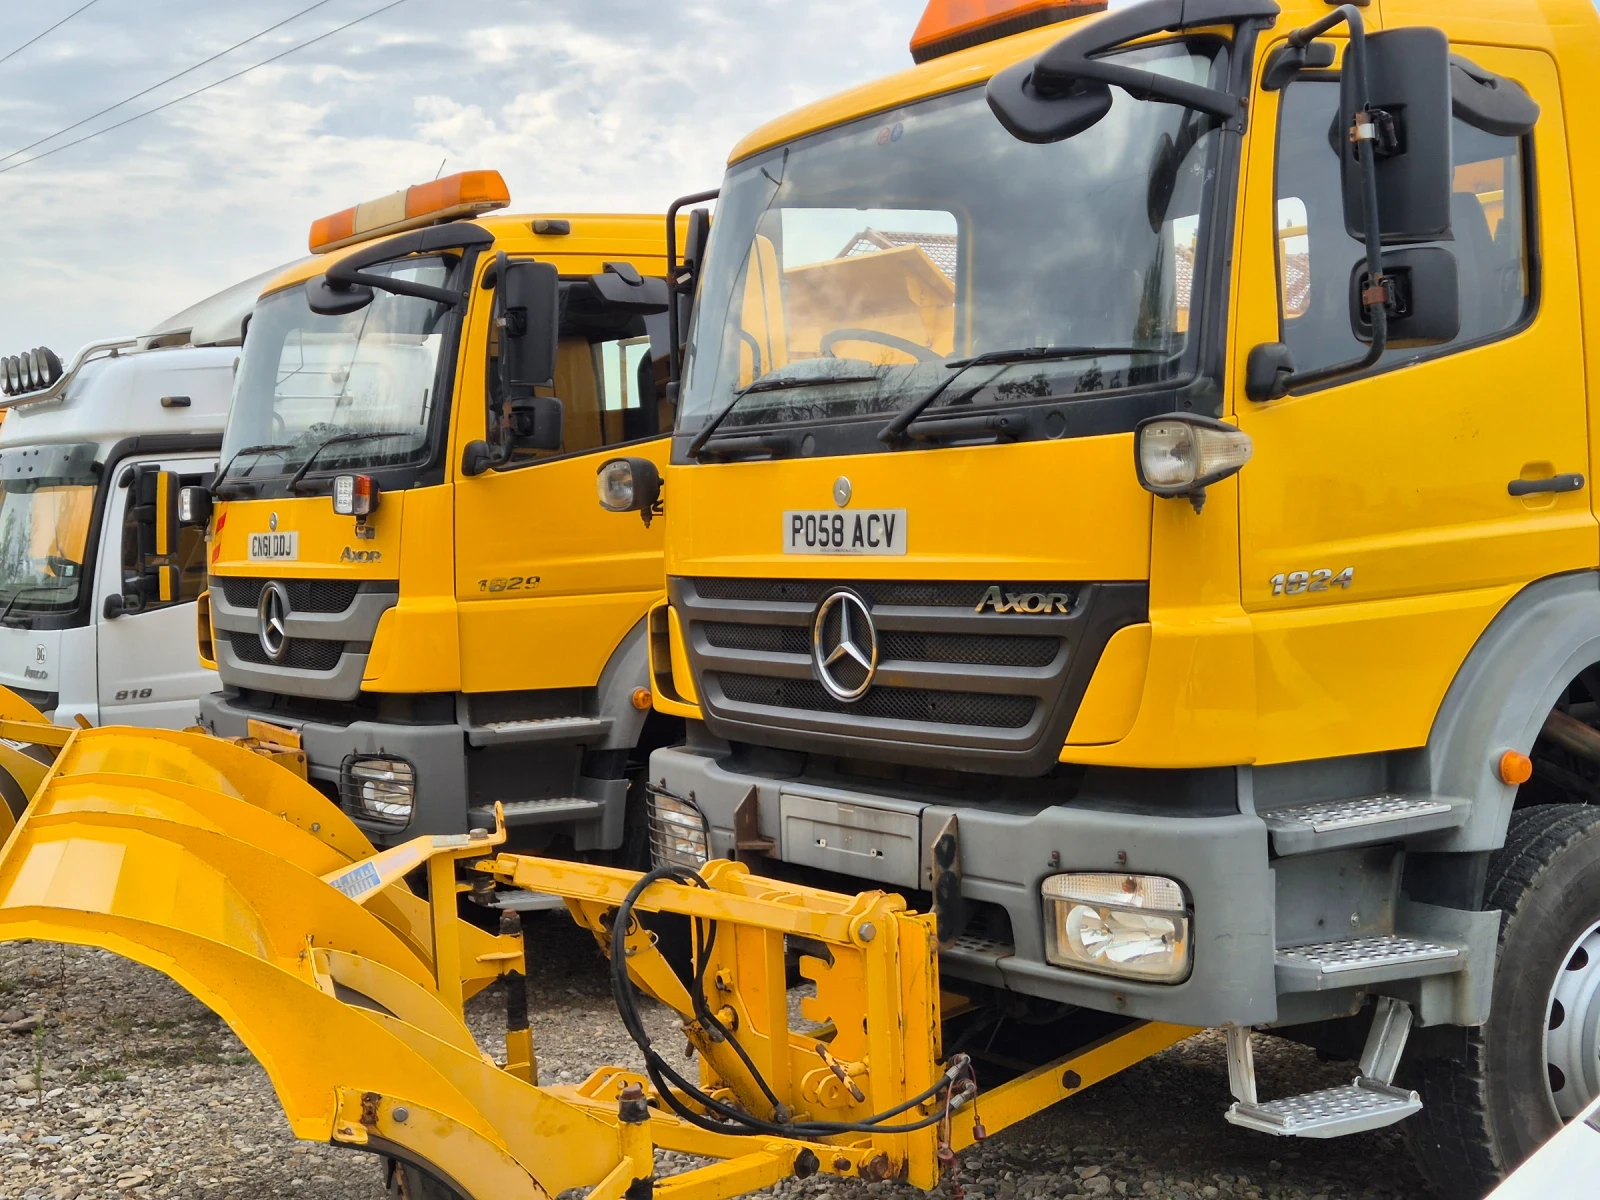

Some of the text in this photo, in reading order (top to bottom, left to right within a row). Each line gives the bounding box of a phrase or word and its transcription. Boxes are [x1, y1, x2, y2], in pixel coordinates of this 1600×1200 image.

[791, 513, 896, 548] PO58 ACV
[252, 534, 292, 557] CN61 DDJ
[477, 575, 541, 593] 1829
[1269, 566, 1354, 596] 1824
[36, 647, 45, 661] BG
[115, 688, 153, 701] 818
